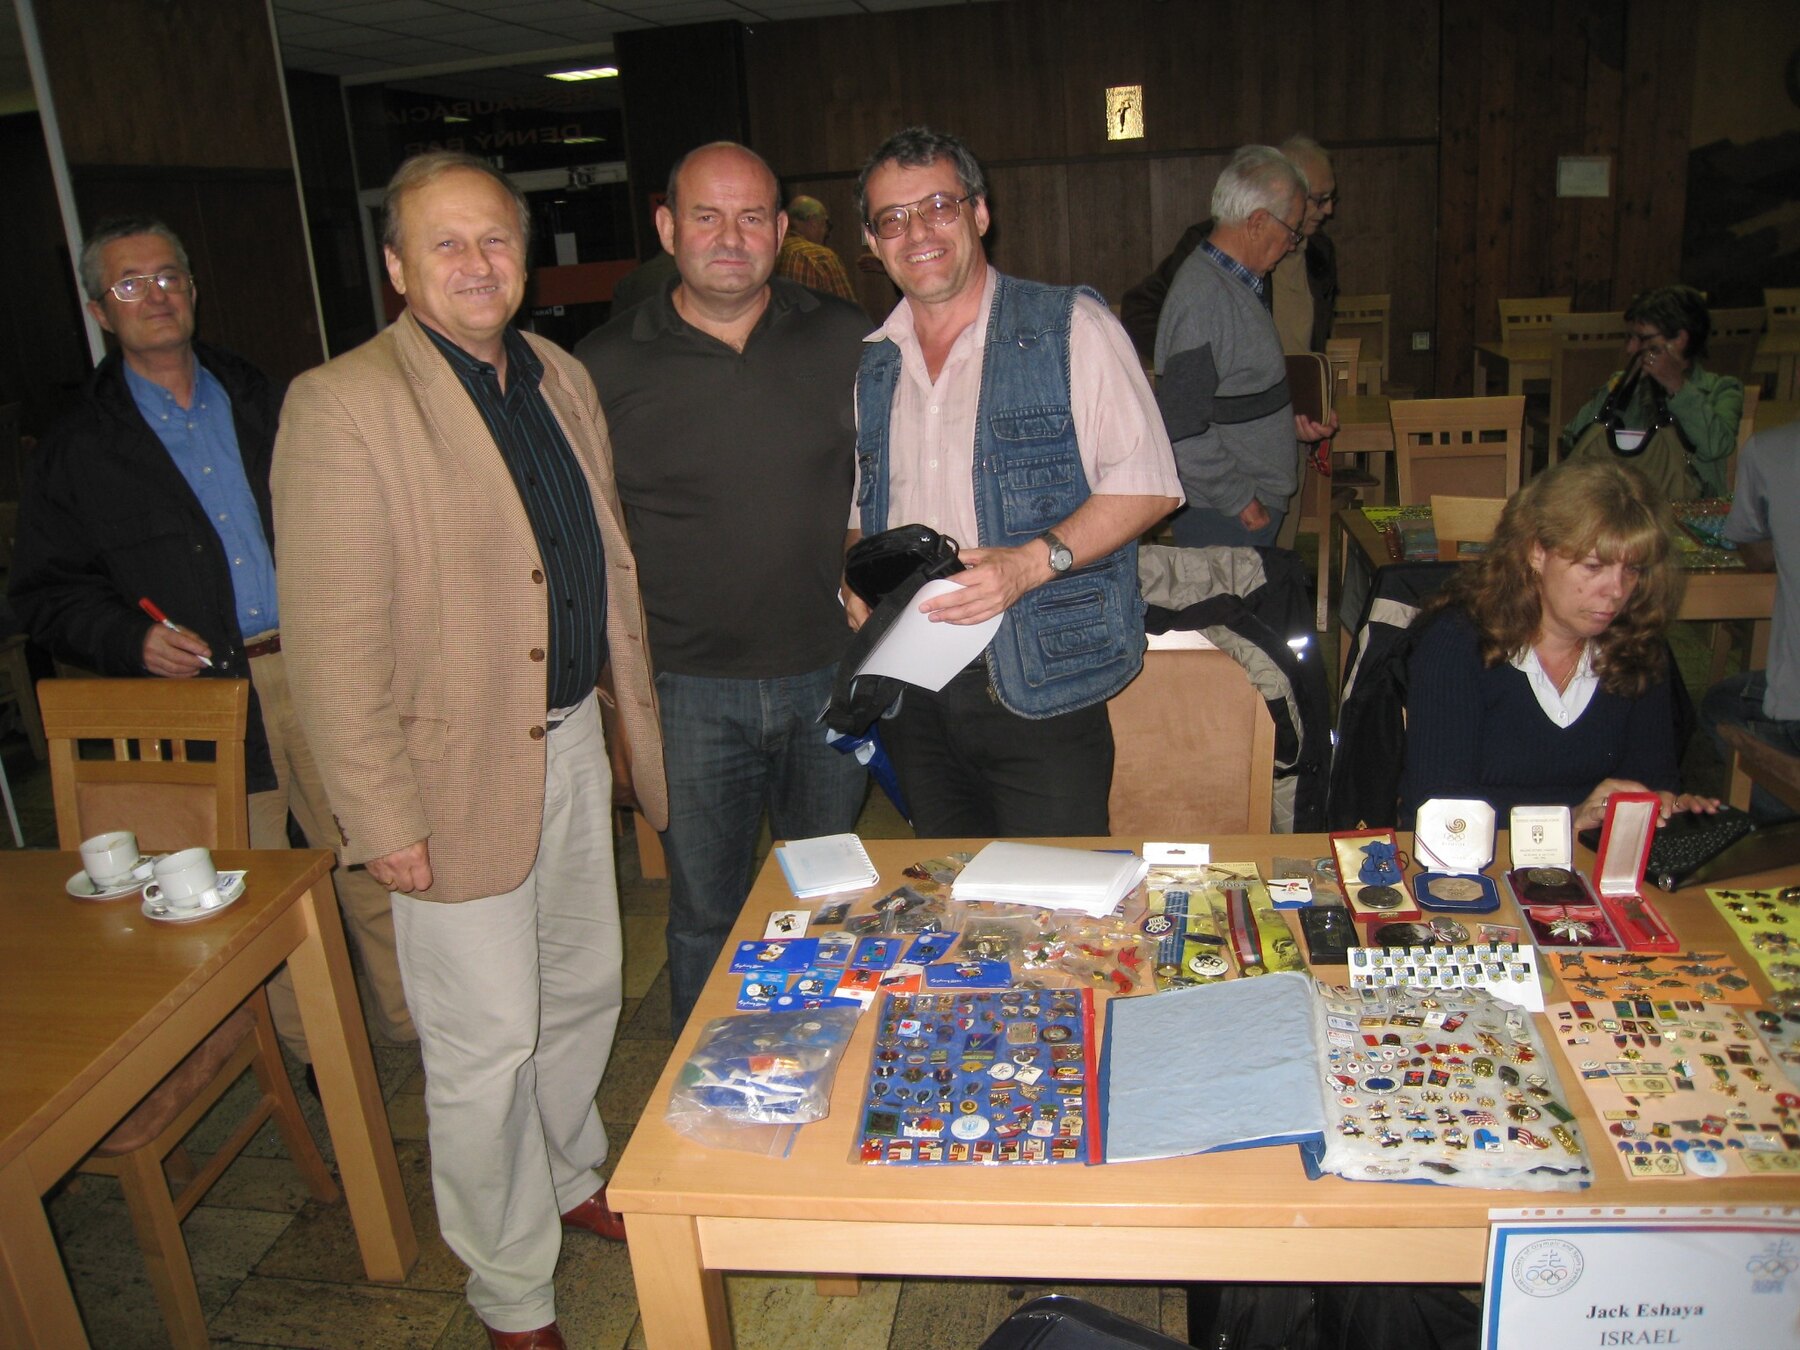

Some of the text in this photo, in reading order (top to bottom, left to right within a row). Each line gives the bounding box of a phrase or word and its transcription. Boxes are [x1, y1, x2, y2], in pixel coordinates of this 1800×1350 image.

[1586, 1303, 1704, 1320] Jack Eshaya
[1600, 1328, 1682, 1346] ISRAEL
